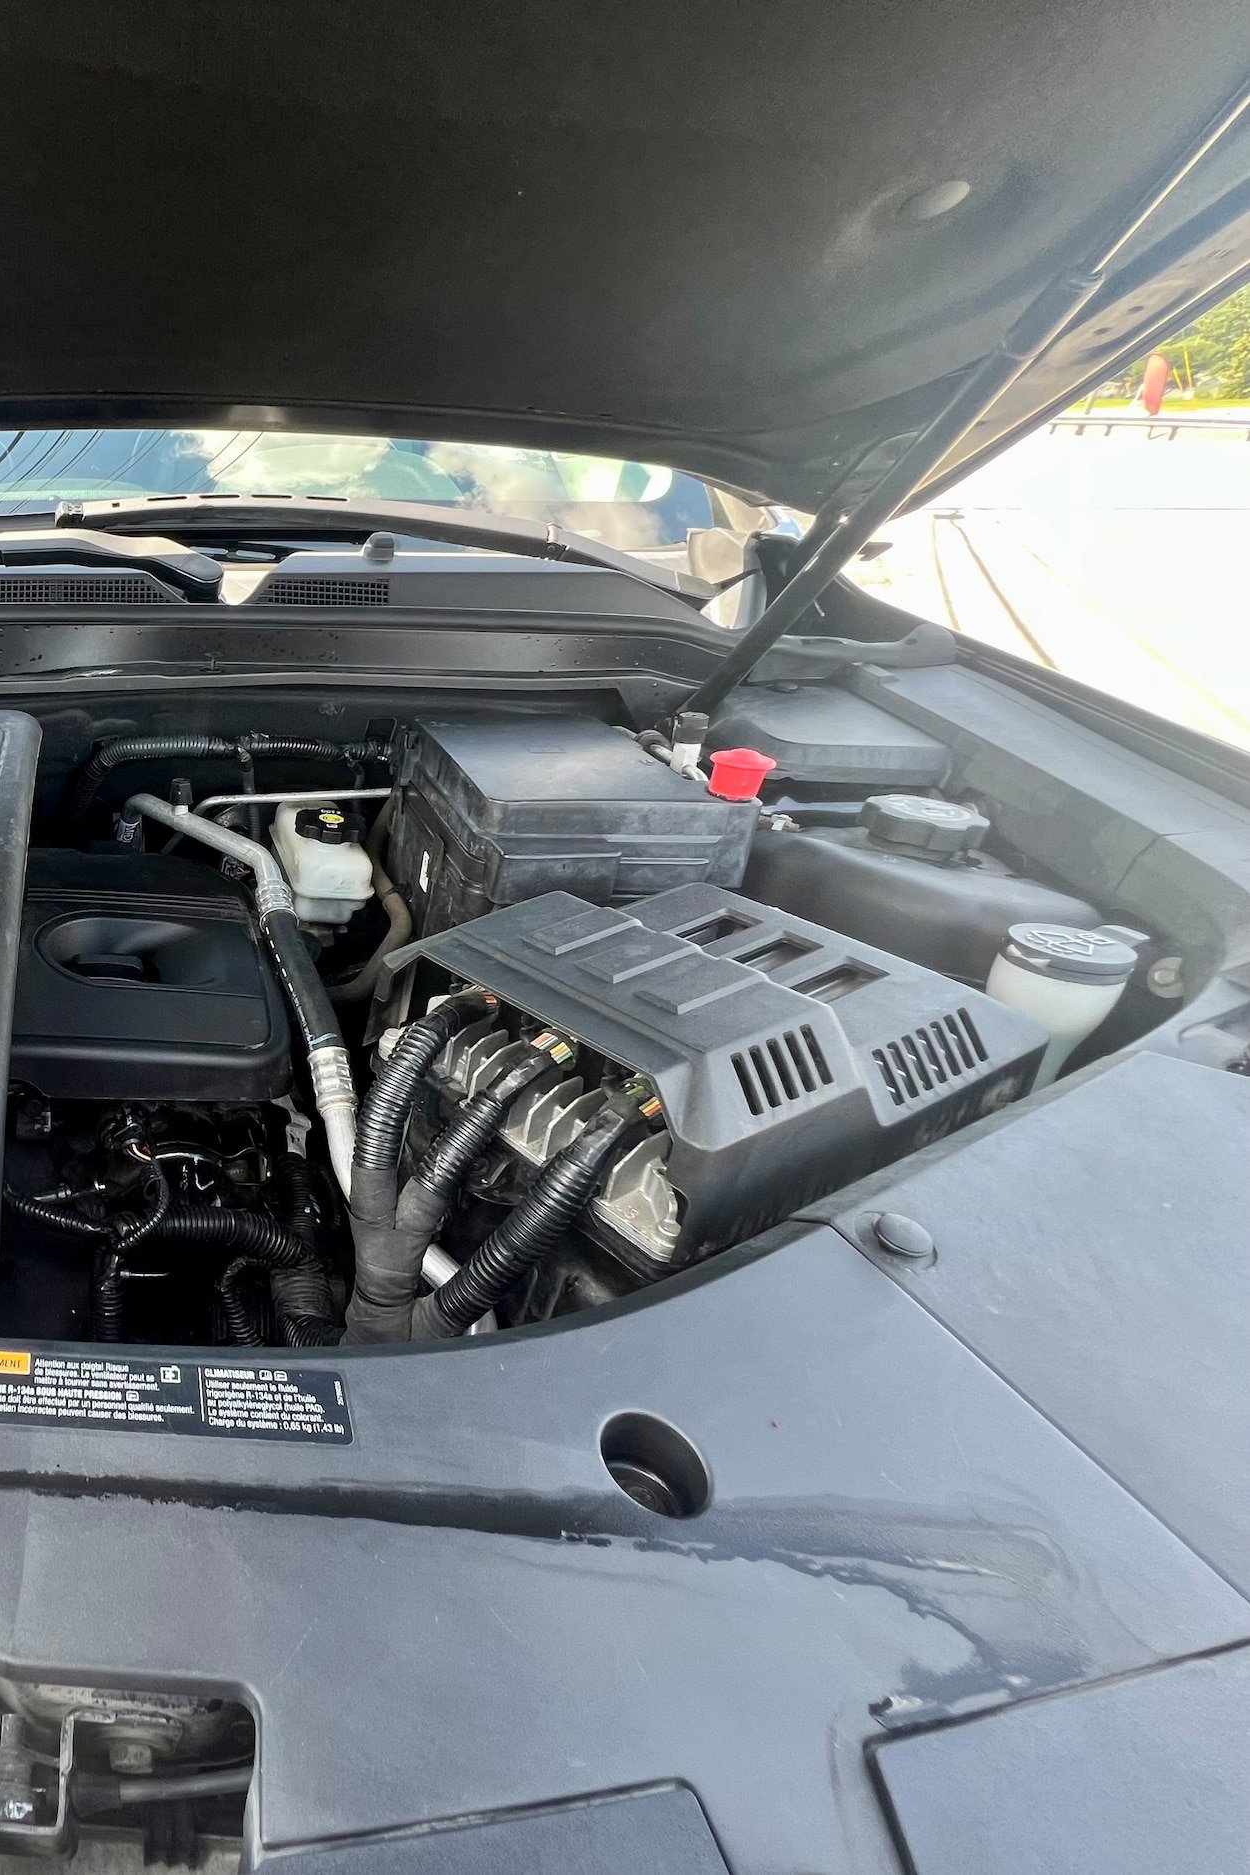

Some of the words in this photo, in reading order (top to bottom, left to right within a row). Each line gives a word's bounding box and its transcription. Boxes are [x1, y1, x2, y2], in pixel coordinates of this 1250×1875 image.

[204, 1368, 255, 1380] CLIMATISEUR
[8, 1384, 35, 1396] R-134a
[36, 1386, 56, 1396] SOUS
[58, 1388, 82, 1398] HAUTE
[84, 1389, 122, 1401] PRESSION
